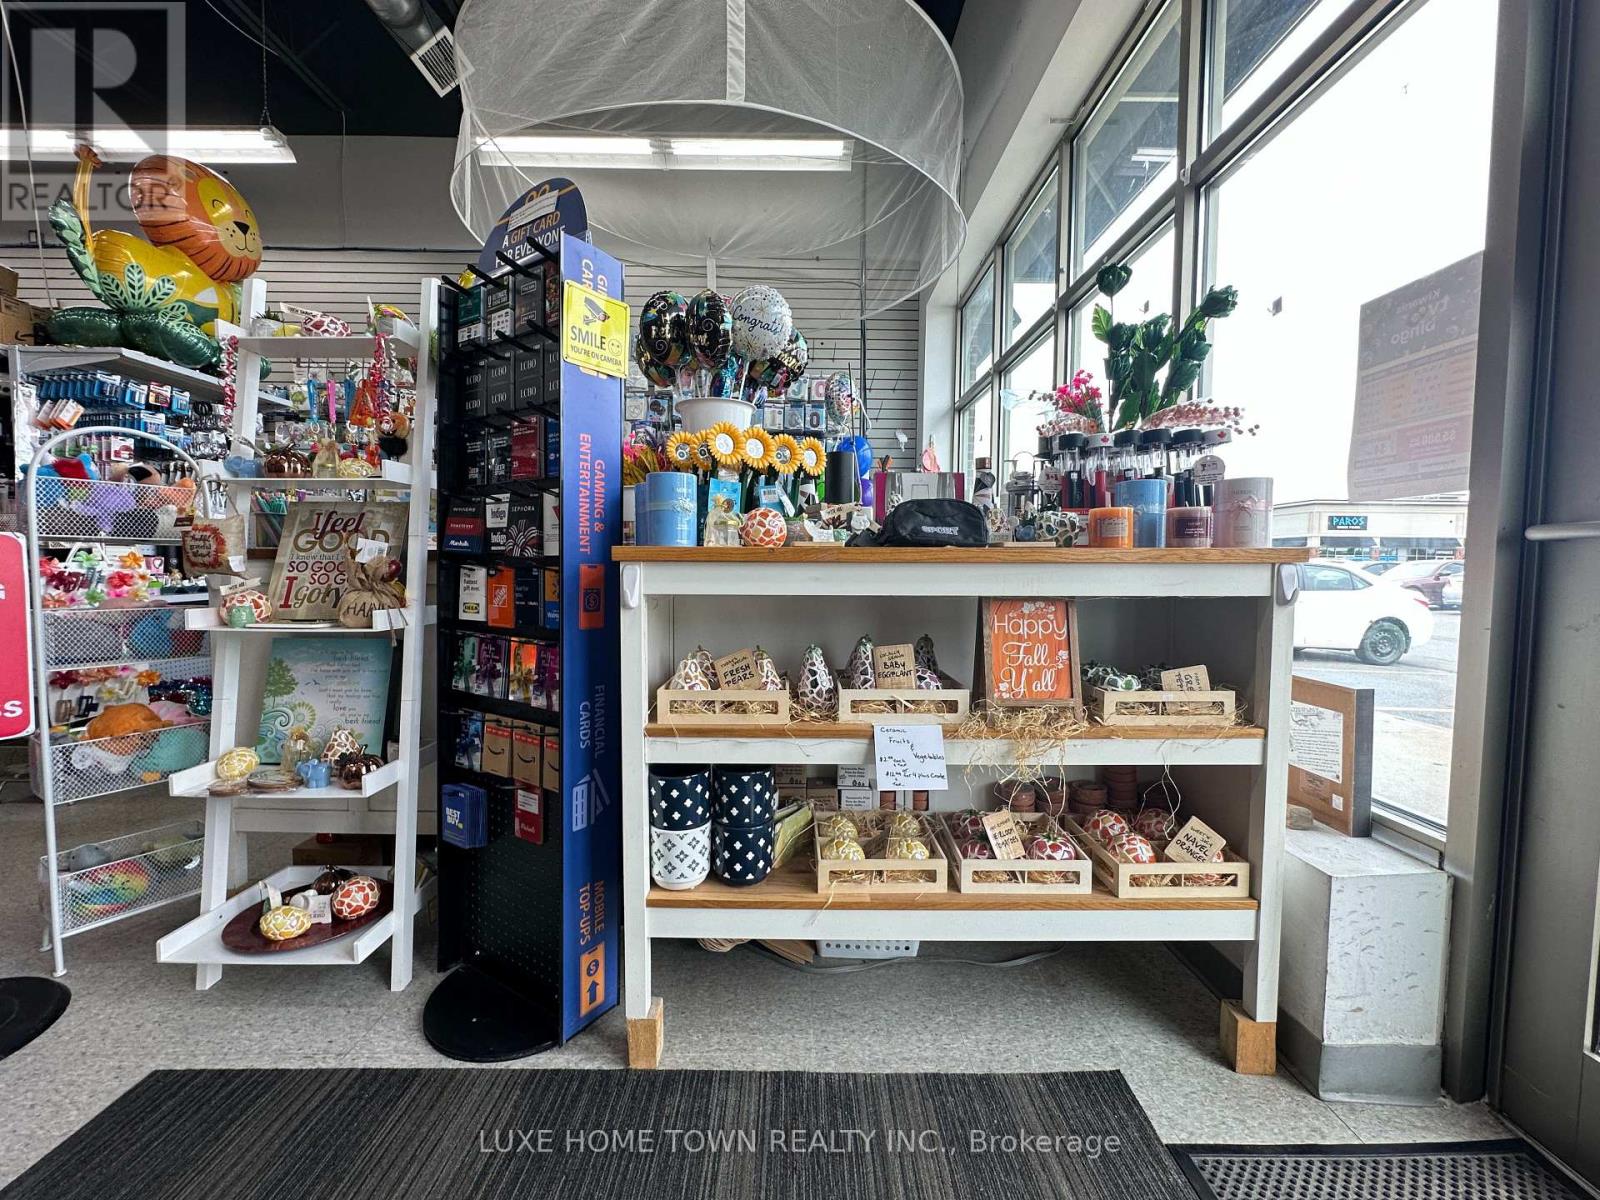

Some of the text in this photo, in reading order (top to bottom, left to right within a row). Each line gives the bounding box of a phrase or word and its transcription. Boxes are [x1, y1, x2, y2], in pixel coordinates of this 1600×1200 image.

[511, 226, 531, 244] GIFT
[532, 211, 561, 234] CARD
[514, 225, 566, 262] EVEYON
[571, 325, 607, 351] SMILE
[571, 345, 622, 366] YOU'RE ON CAMERA
[579, 433, 591, 554] ENTERTAINMENT
[595, 459, 605, 518] GAMING
[1333, 517, 1366, 526] PAROS
[287, 561, 308, 573] SO
[309, 573, 330, 585] SO
[994, 615, 1068, 641] Happy
[1002, 642, 1050, 668] Fall
[723, 663, 751, 679] FRESH
[724, 671, 755, 687] PEARS
[877, 669, 913, 679] EGGPLANT
[1000, 667, 1057, 699] Y'all
[580, 701, 591, 749] CARDS
[594, 685, 605, 759] FINANCIAL
[445, 807, 461, 818] BEST
[1175, 839, 1207, 863] ORANGES
[1183, 833, 1209, 857] NAVEL
[579, 883, 591, 945] TOP-UPS
[594, 880, 605, 934] MOBILE
